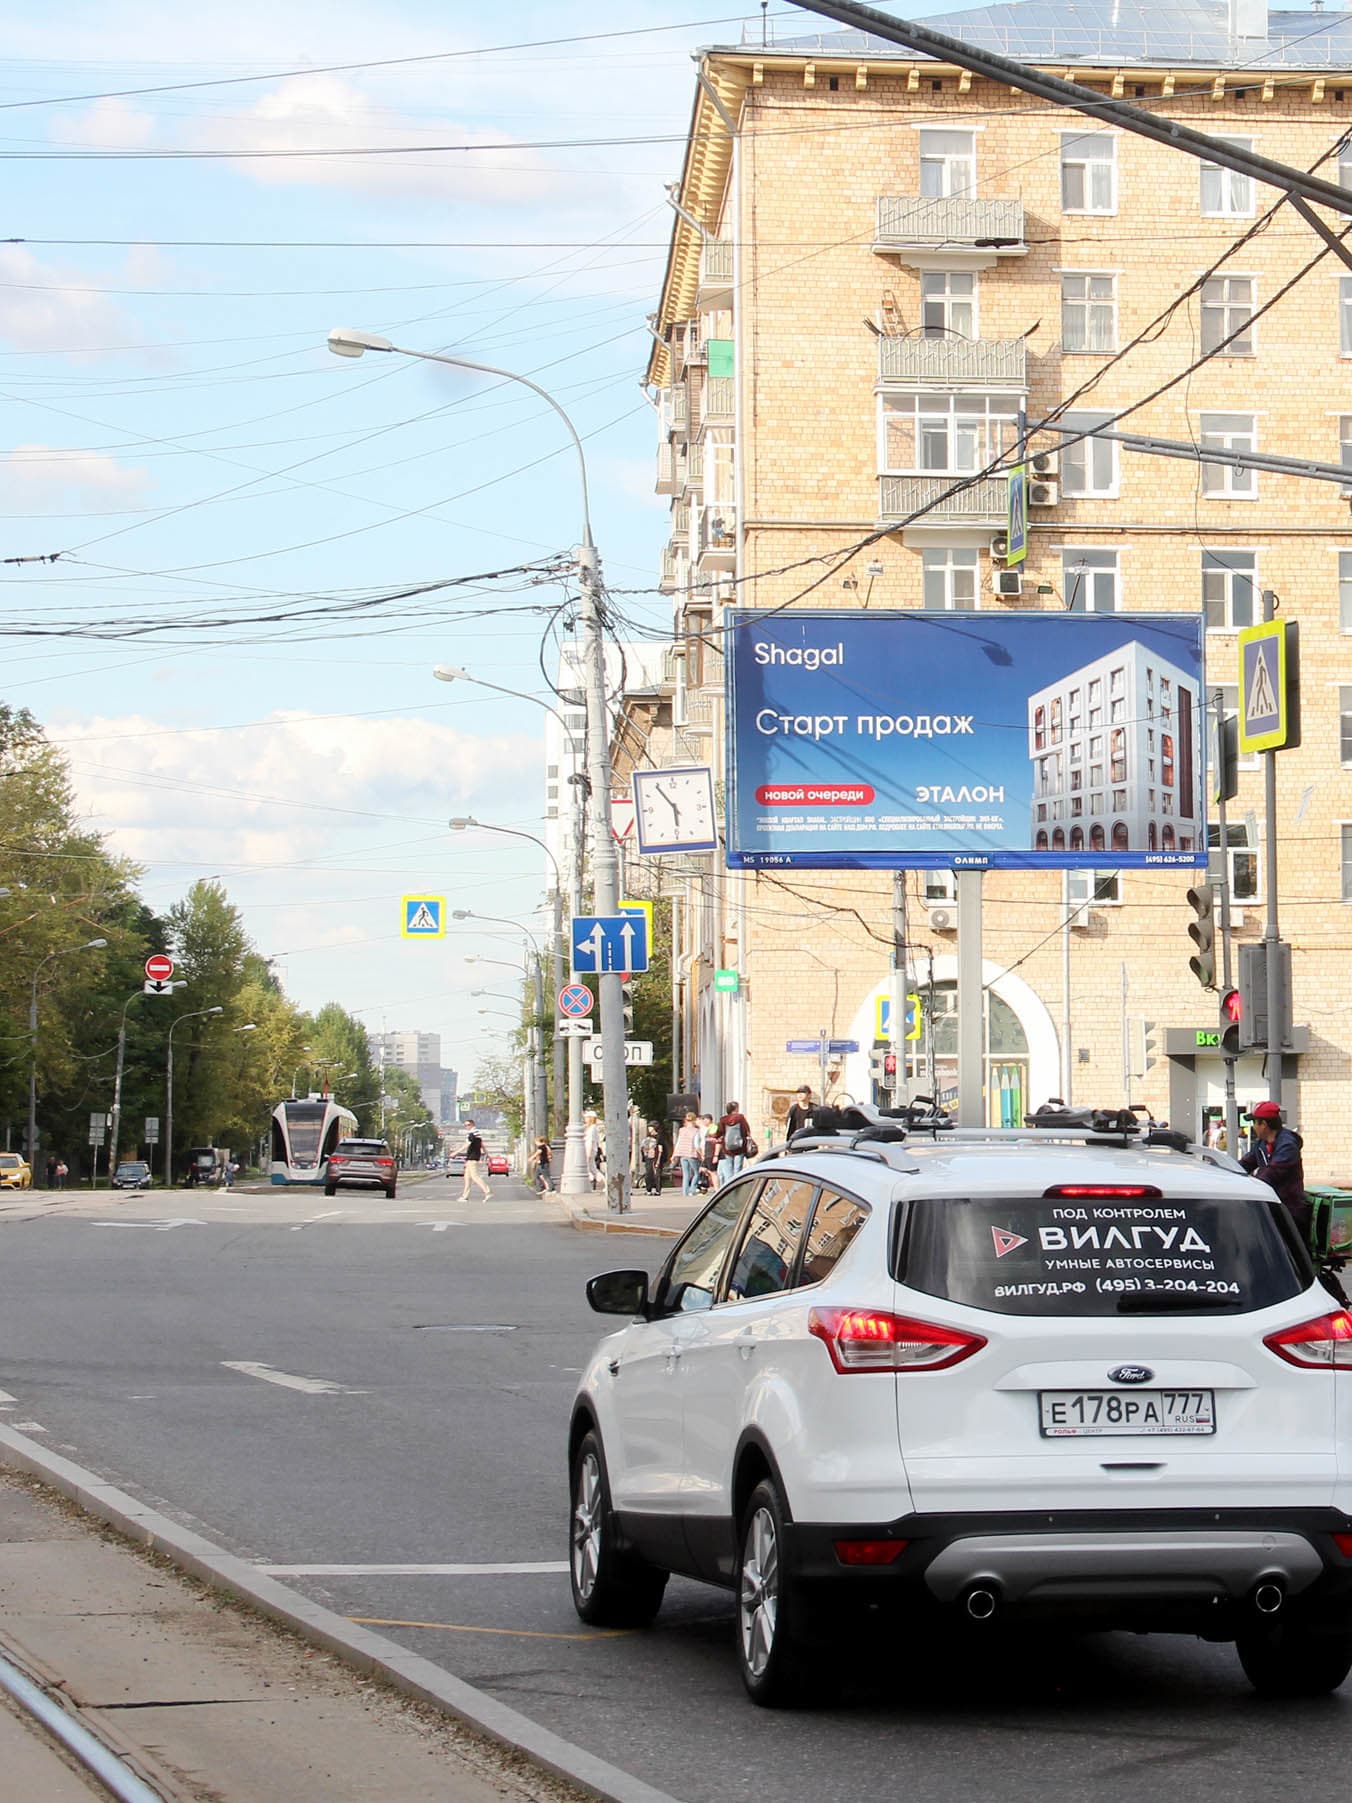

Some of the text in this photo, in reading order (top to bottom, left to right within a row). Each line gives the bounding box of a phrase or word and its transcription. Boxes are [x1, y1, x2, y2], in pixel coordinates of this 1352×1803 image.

[754, 642, 844, 671] Shagal
[755, 708, 975, 741] Старт продаж
[764, 788, 864, 803] новой очереди
[915, 785, 1005, 803] ЭТАЛОН
[954, 856, 989, 865] ОЛИМП
[593, 1045, 642, 1061] СП
[1053, 1208, 1186, 1220] ПОД КОНТРОЛЕМ
[1038, 1226, 1211, 1253] ВИЛГУД
[1045, 1258, 1215, 1271] УМНЫЕ АВТОСЕРВИСЫ
[994, 1278, 1240, 1297] ВИЛГУД.РФ (495) 3-204-204
[1118, 1367, 1146, 1381] Ford
[1051, 1393, 1204, 1424] Е178РА 777
[1175, 1415, 1195, 1424] RUS
